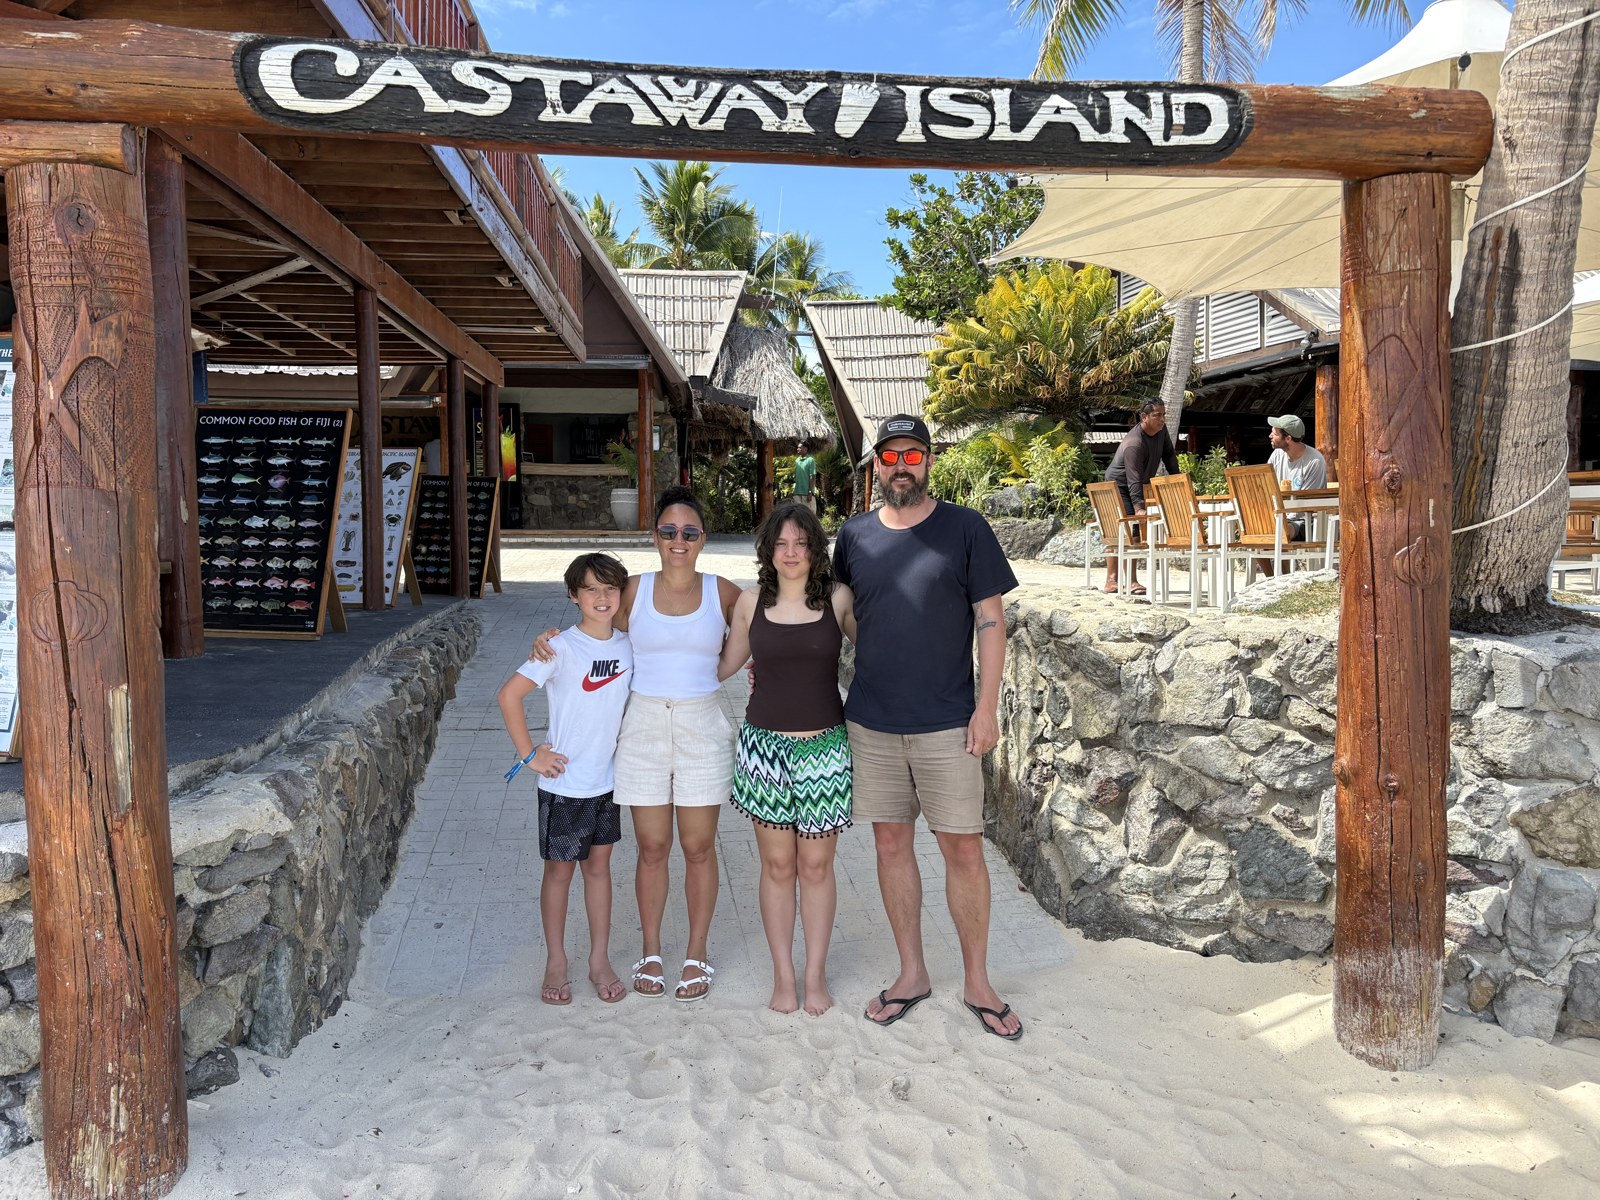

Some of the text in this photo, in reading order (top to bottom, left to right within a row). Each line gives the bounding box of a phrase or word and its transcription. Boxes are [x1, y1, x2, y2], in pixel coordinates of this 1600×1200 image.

[258, 43, 1229, 147] CASTAWAY ISLAND
[199, 415, 343, 428] COMMON FOOD FISH OF FIJI (2)
[422, 479, 446, 487] COMMON
[590, 659, 620, 678] NIKE
